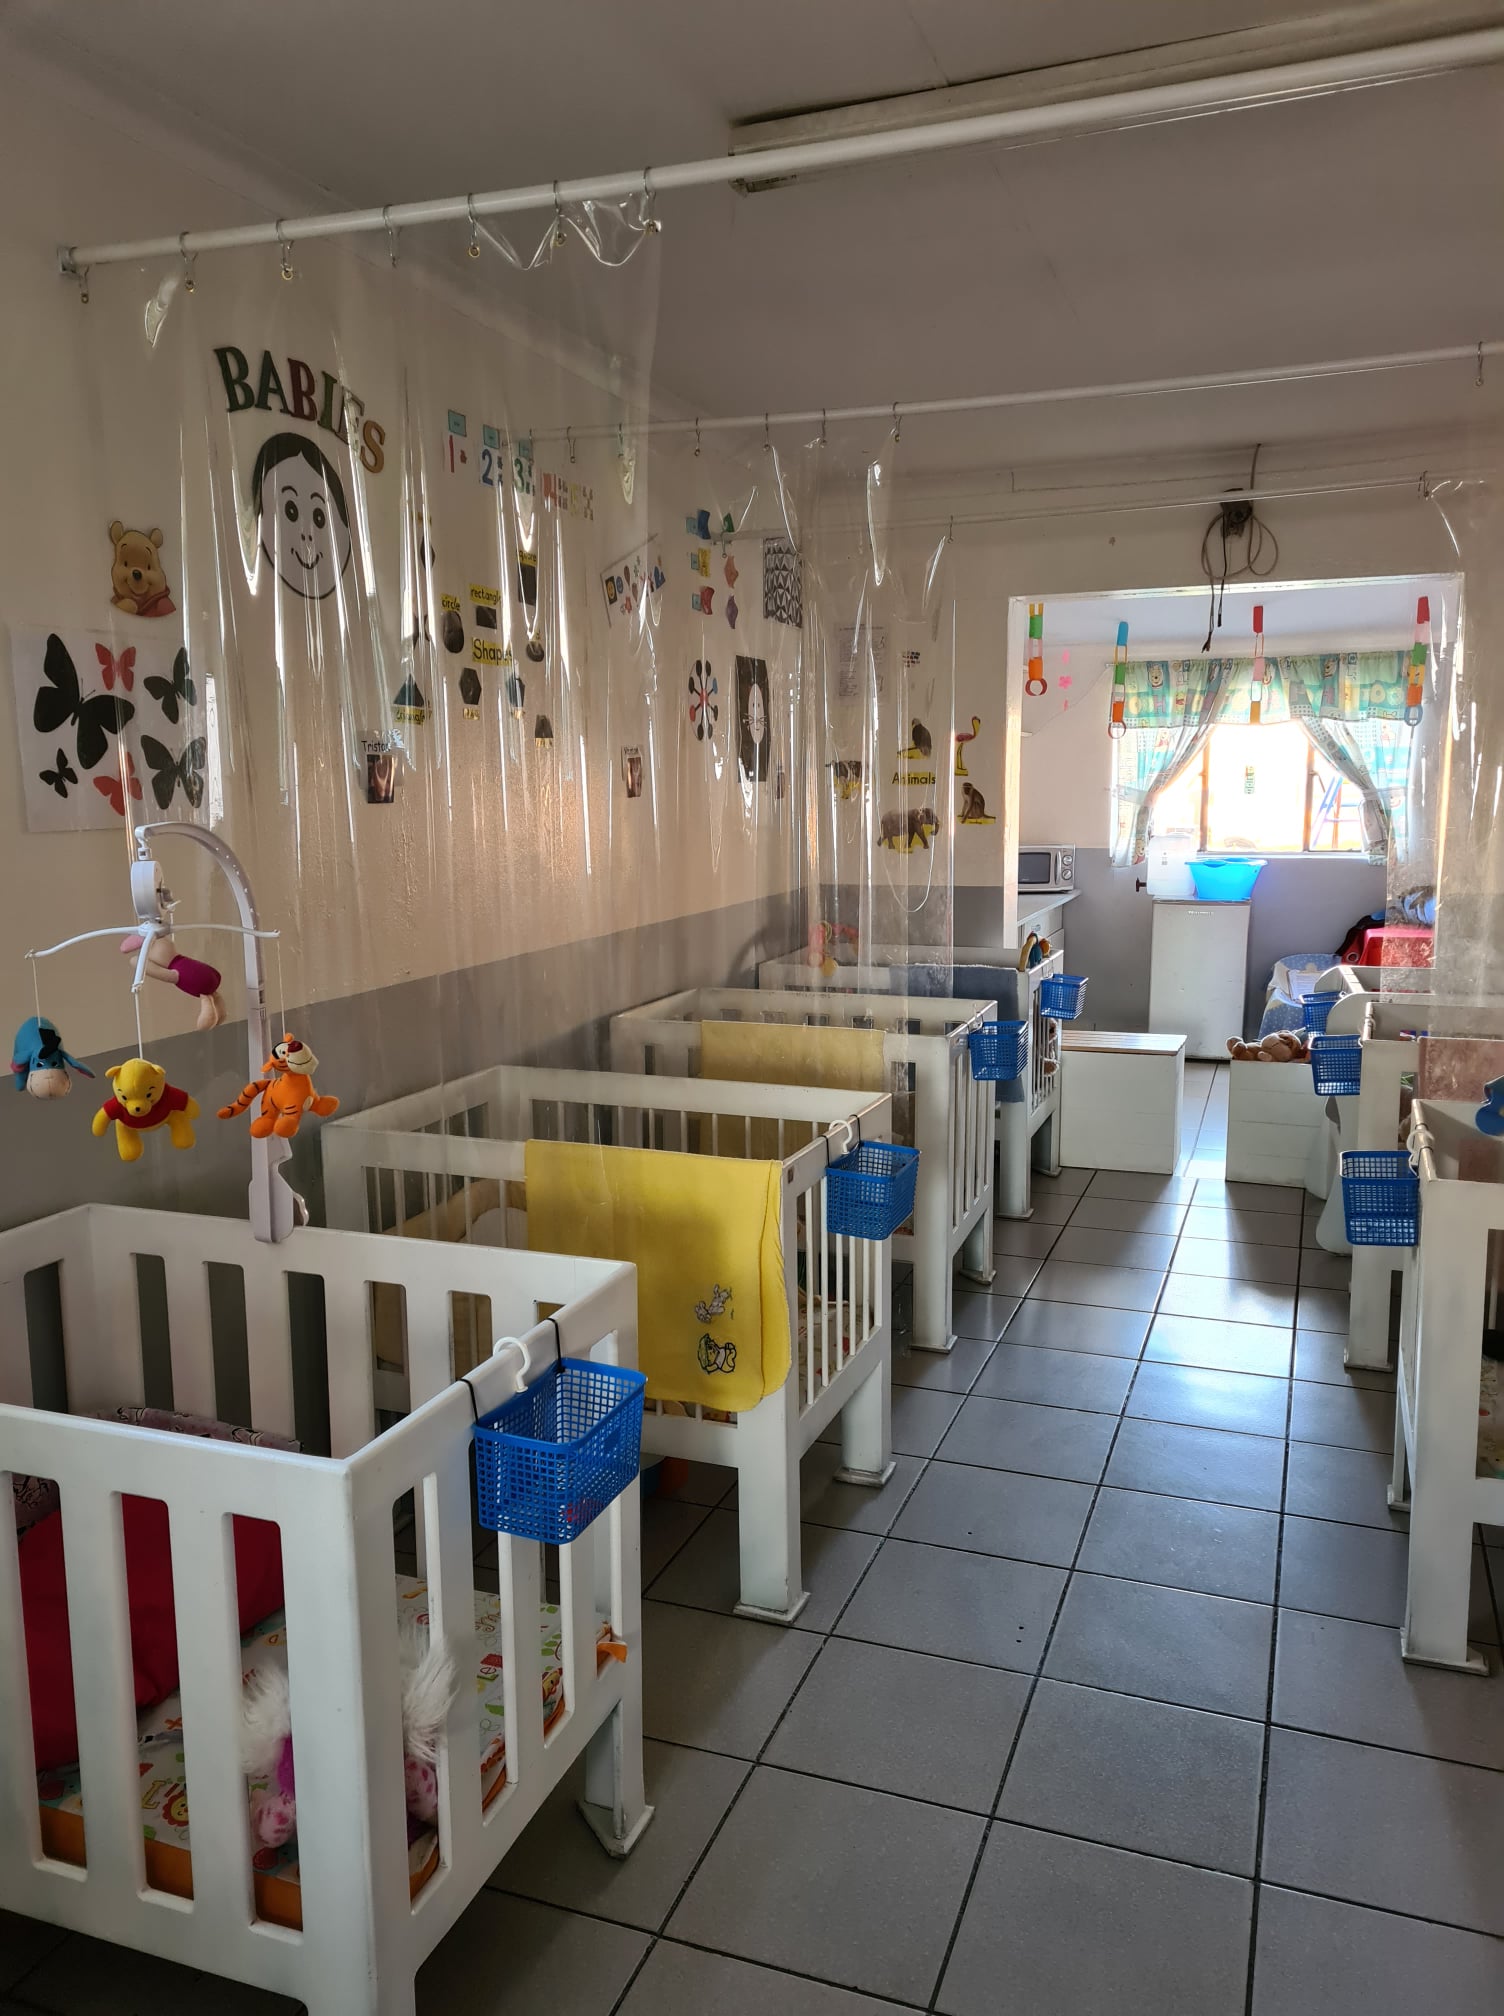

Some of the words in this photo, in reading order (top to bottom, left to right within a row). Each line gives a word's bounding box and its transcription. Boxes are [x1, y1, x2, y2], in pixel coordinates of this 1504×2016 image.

[213, 346, 386, 474] BABIES
[481, 448, 494, 486] 2
[892, 772, 936, 785] Animals
